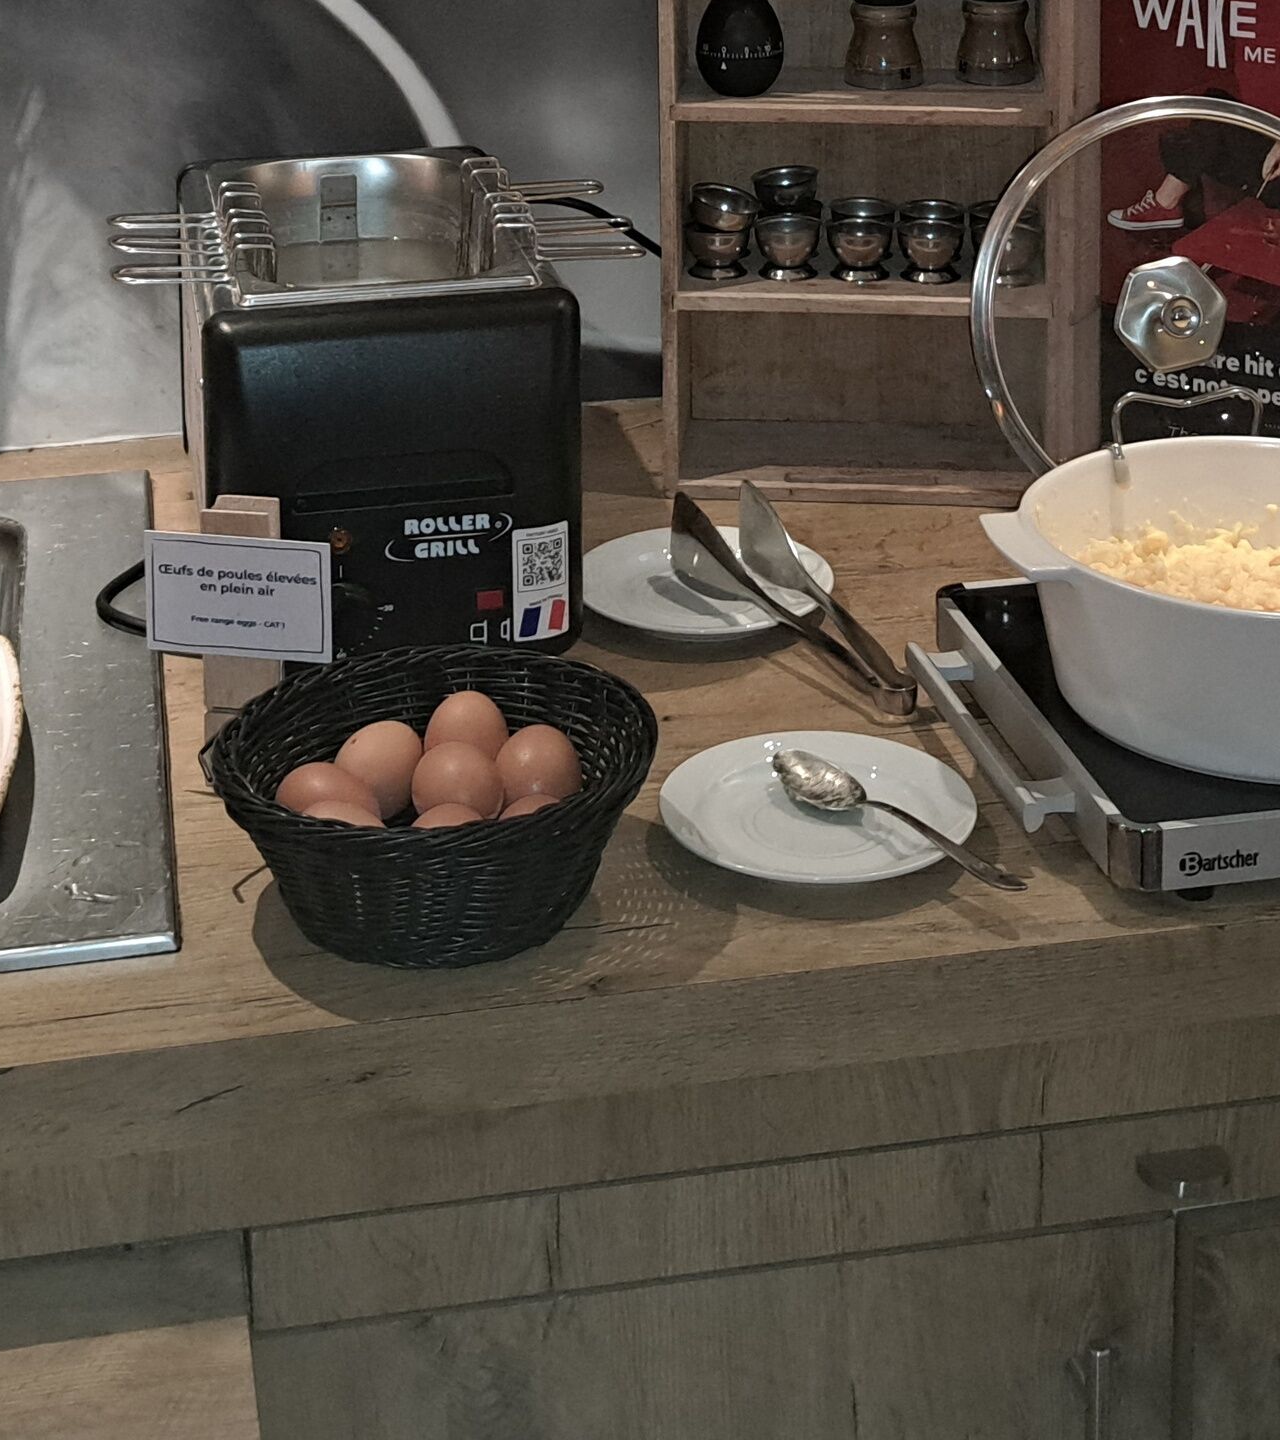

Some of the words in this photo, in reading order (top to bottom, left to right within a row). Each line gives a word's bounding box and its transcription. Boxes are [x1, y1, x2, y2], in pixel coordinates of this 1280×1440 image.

[1244, 46, 1277, 64] ME
[1245, 354, 1274, 377] hit
[404, 513, 490, 536] ROLLER
[414, 538, 480, 559] GRILL
[158, 563, 194, 576] Œufs
[197, 566, 214, 578] de
[217, 568, 262, 582] poules
[266, 571, 317, 586] élevées
[200, 583, 217, 592] en
[221, 582, 254, 595] plein
[258, 584, 275, 596] air
[1179, 849, 1259, 876] Bartscher
